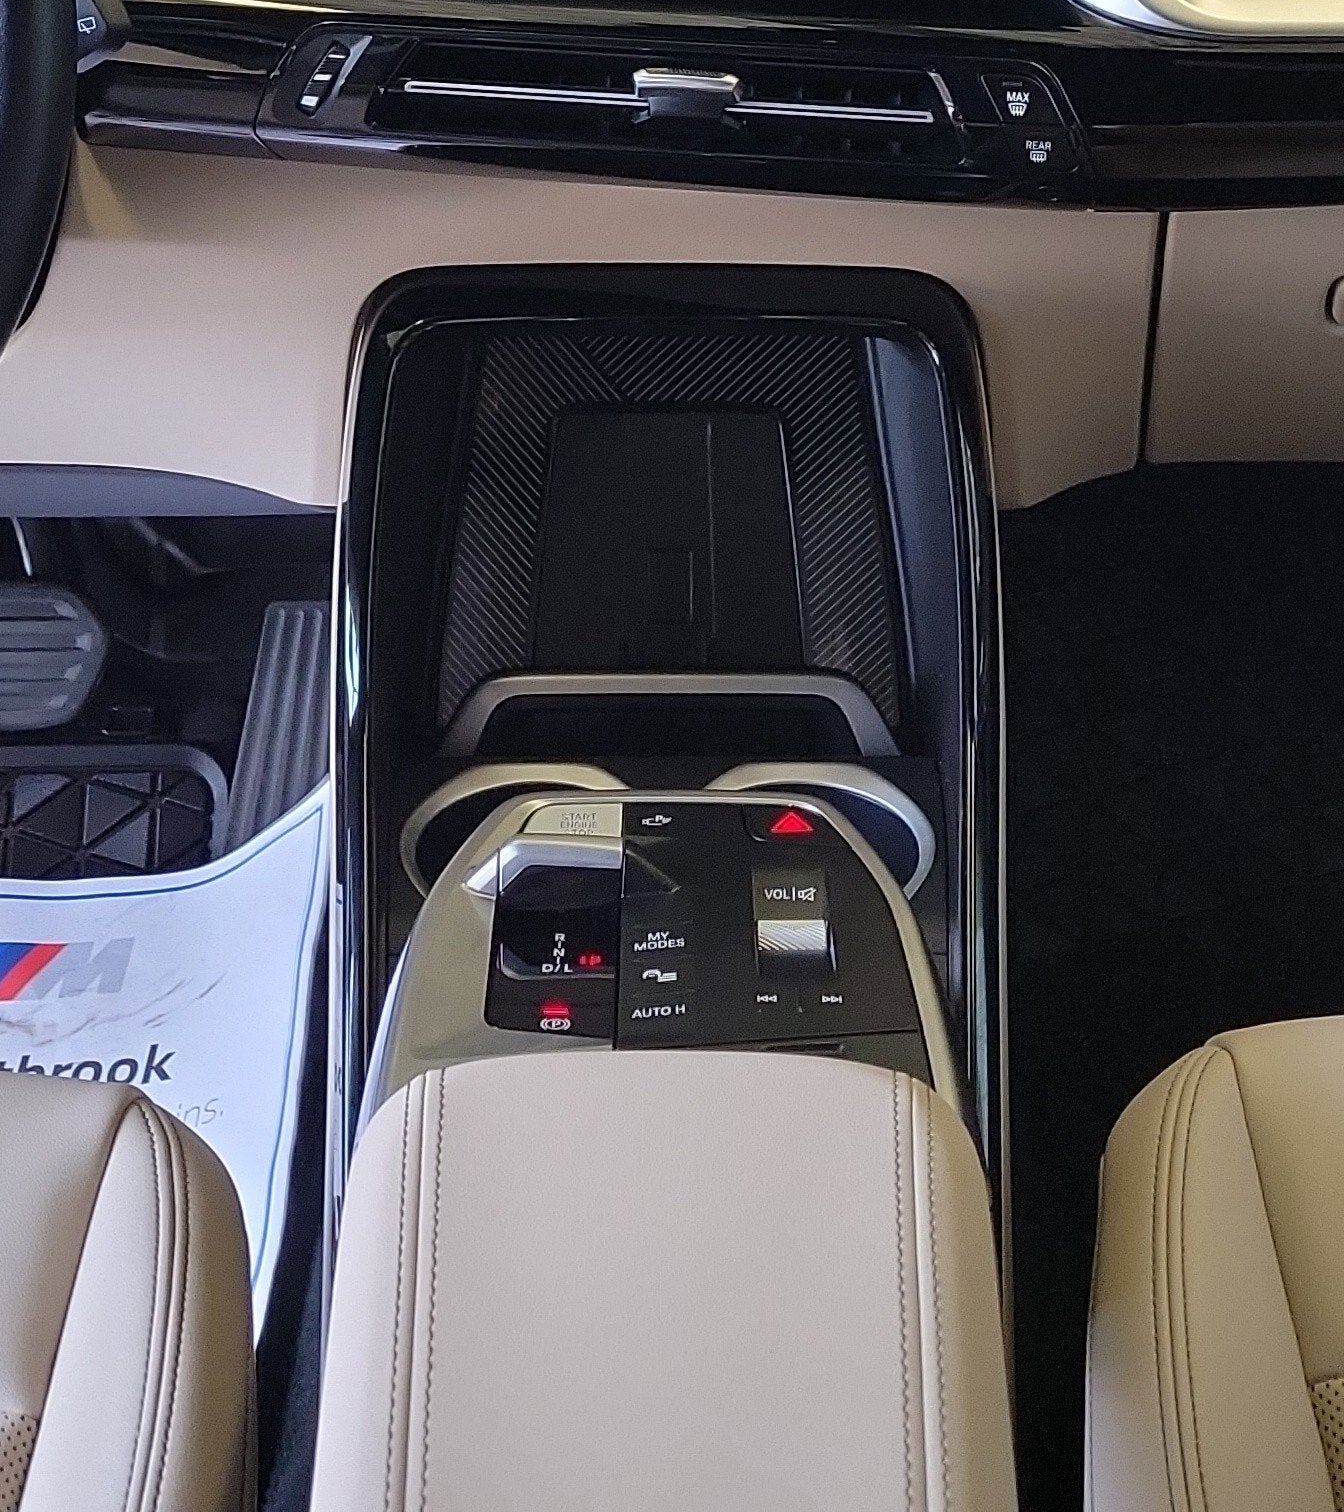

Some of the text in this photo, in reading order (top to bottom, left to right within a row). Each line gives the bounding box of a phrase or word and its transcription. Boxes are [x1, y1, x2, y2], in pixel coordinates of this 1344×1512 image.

[1006, 91, 1030, 103] MAX
[1025, 140, 1052, 151] REAR
[562, 813, 597, 821] START
[764, 889, 791, 900] VOL
[555, 933, 566, 942] R
[647, 931, 670, 941] MY
[633, 938, 685, 952] MODES
[553, 948, 565, 956] N
[631, 1004, 686, 1019] AUTO H
